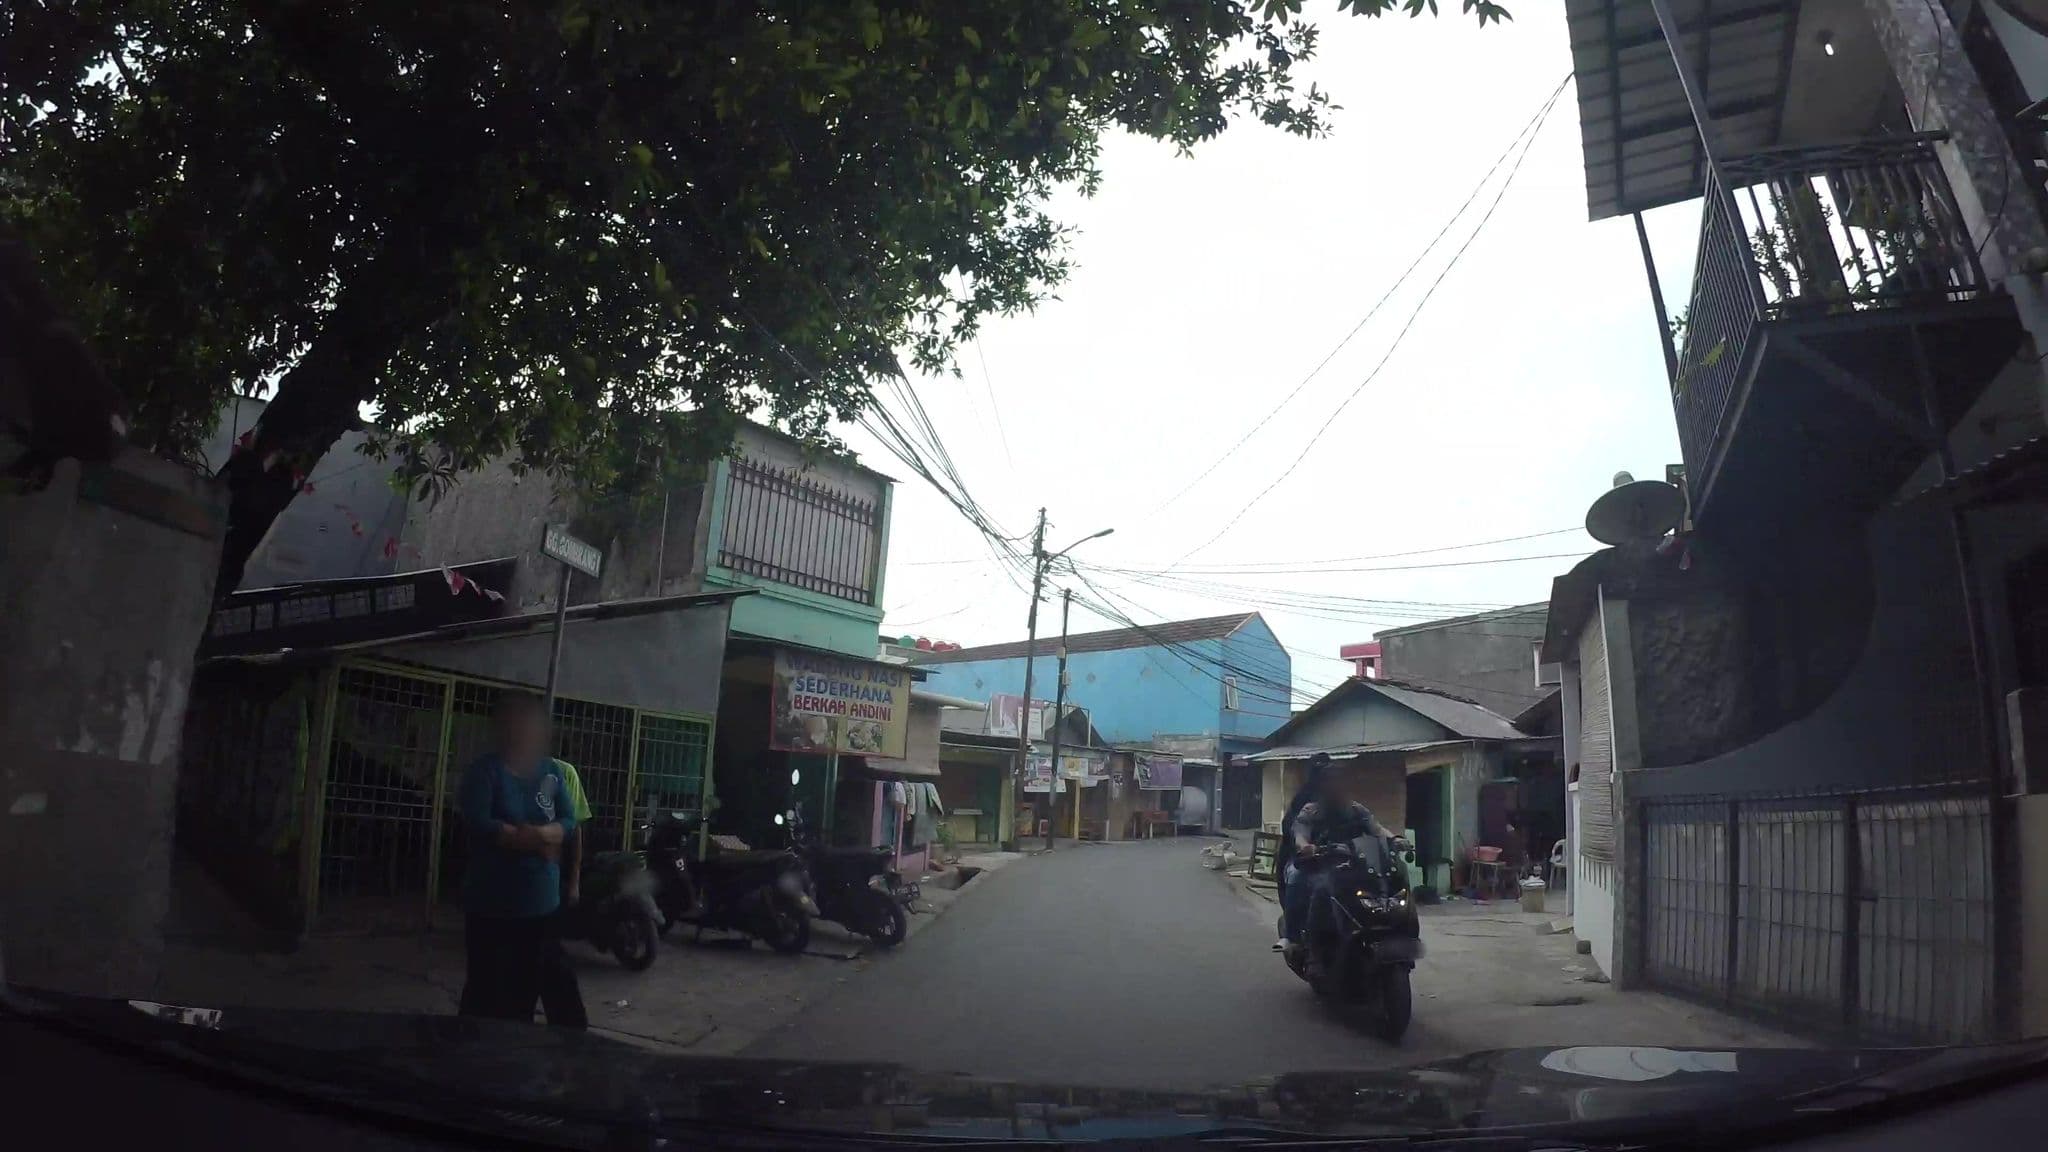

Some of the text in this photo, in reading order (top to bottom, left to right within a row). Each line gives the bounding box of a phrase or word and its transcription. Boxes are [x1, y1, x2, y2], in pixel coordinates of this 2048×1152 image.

[795, 675, 893, 703] SEDERHANA
[867, 664, 902, 688] NASI
[793, 694, 892, 722] BERKAH ANDINI
